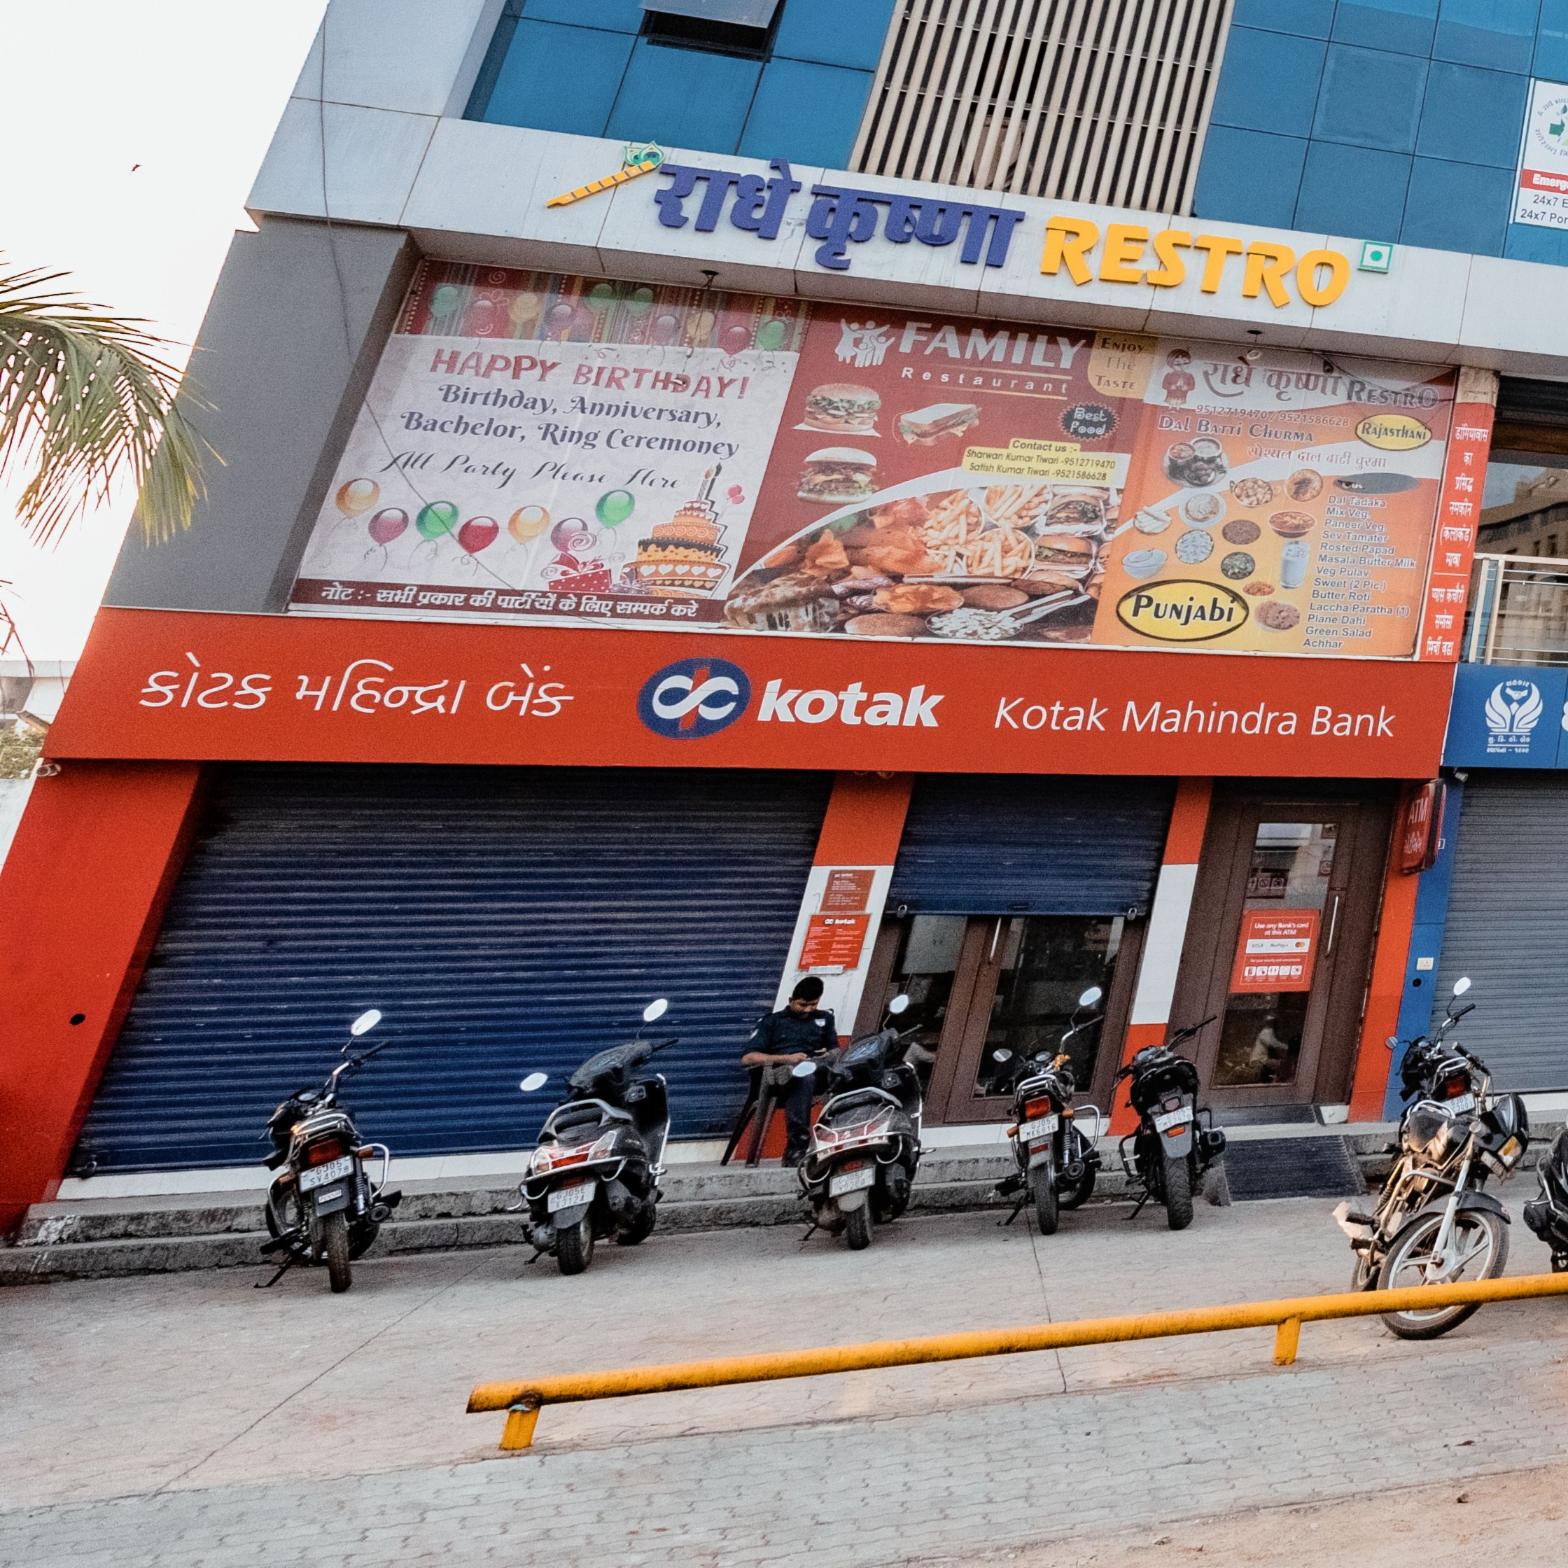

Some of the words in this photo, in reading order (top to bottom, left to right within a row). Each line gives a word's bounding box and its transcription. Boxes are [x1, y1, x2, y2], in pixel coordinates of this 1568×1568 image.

[1532, 193, 1559, 207] 24x7
[1520, 208, 1547, 221] 24x7
[652, 158, 801, 241] राधे
[806, 183, 1026, 271] कृष्णा
[1038, 215, 1351, 309] RESTRO
[898, 320, 1087, 370] FAMILY
[429, 347, 563, 384] HAPPY
[572, 363, 751, 401] BIRTHDAY!
[901, 366, 1069, 395] Restaurant
[1201, 356, 1256, 399] राधे
[1263, 368, 1347, 403] कृष्णा
[437, 383, 559, 417] Birthday,
[562, 395, 723, 431] Anniversary,
[399, 410, 527, 443] Bachelor,
[536, 422, 602, 452] Ring
[605, 428, 741, 461] Ceremoney
[1011, 439, 1052, 453] Contact
[1052, 443, 1068, 453] us
[965, 448, 1004, 463] Sharwan
[1005, 452, 1035, 464] Kumar
[1035, 453, 1060, 466] Tiwari
[968, 461, 995, 473] Satish
[996, 463, 1026, 476] Kumar
[1026, 466, 1051, 477] Tiwari
[1326, 506, 1345, 517] Mix
[1324, 518, 1362, 531] Paneer
[1319, 542, 1361, 554] Rosted
[1361, 545, 1396, 557] Papad
[1317, 553, 1357, 565] Masala
[1316, 566, 1337, 577] Veg
[1313, 577, 1348, 589] Sweet
[320, 585, 354, 603] नोट
[375, 586, 416, 606] सभी
[416, 589, 466, 610] प्रकार
[467, 587, 494, 610] की
[559, 592, 578, 613] के
[578, 594, 614, 618] लिए
[615, 597, 672, 618] सम्पर्क
[1311, 589, 1346, 601] Butter
[1348, 591, 1371, 602] Roti
[1309, 602, 1351, 613] Laccha
[1352, 604, 1394, 616] Paratha
[1307, 613, 1339, 625] Plane
[1341, 615, 1367, 625] Dahi
[1305, 625, 1339, 637] Green
[1341, 627, 1373, 638] Salad
[1302, 637, 1345, 650] Achhar
[138, 651, 274, 711] કોટક
[296, 658, 469, 717] મહિન્દ્રા
[485, 663, 575, 719] બેંક
[756, 677, 945, 729] kotak
[993, 695, 1107, 734] Kotak
[1120, 697, 1299, 737] Mahindra
[1308, 705, 1397, 740] Bank
[1408, 797, 1430, 825] ATM
